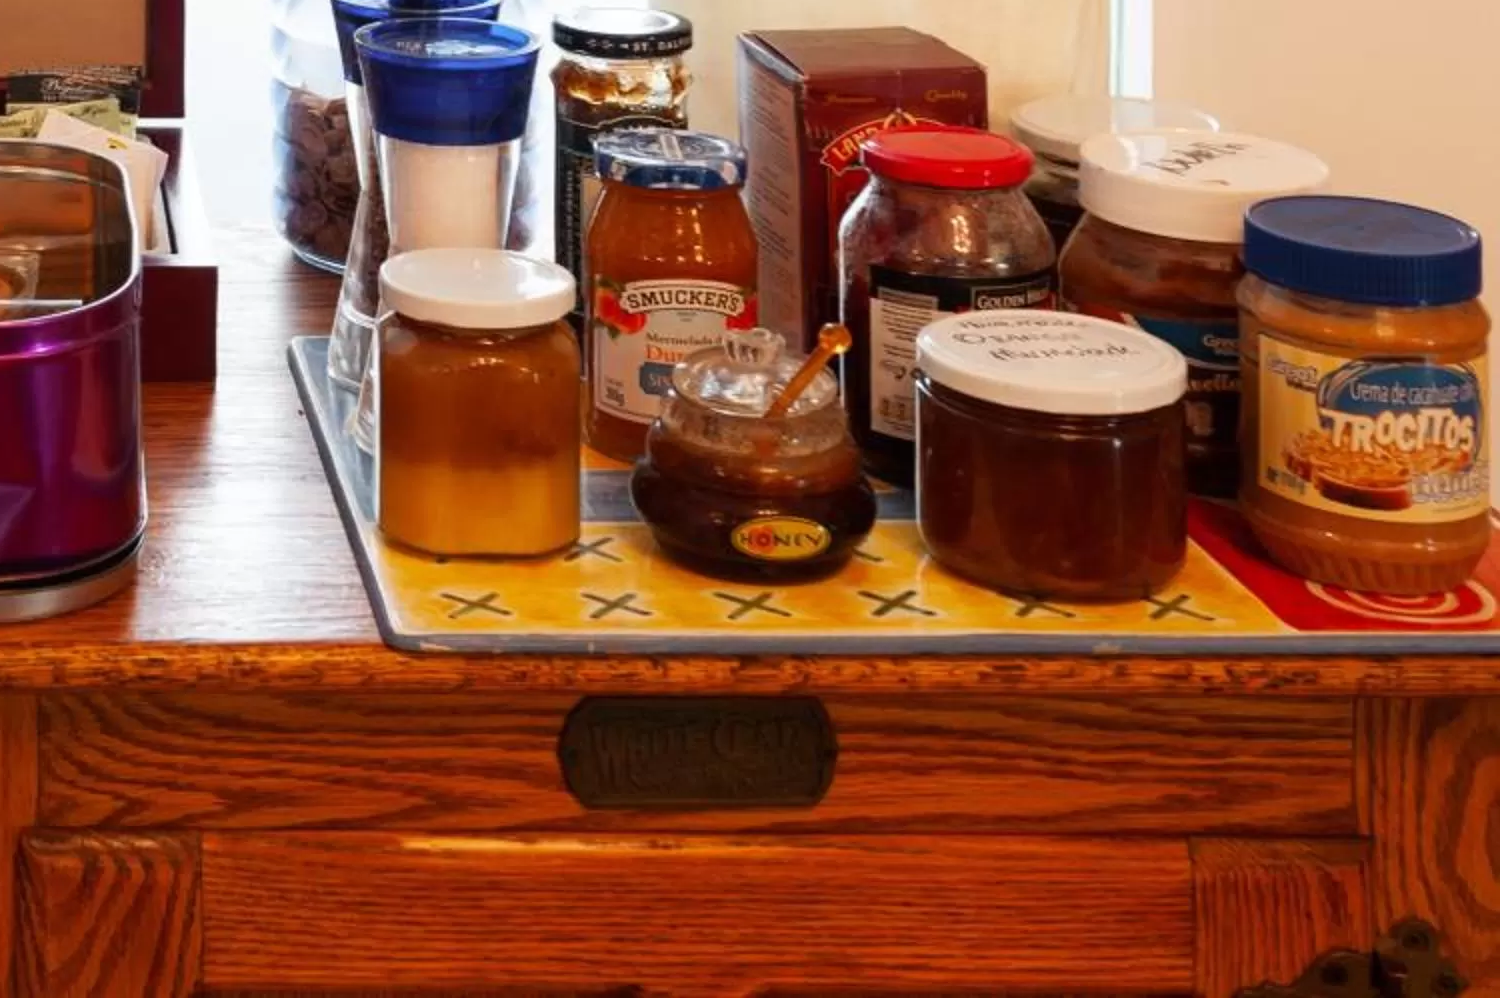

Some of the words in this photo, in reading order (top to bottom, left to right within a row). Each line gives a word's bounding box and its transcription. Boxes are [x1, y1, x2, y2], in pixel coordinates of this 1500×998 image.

[626, 289, 741, 313] SMUCKER'S
[1350, 378, 1389, 402] Crema
[1392, 381, 1407, 404] de
[1318, 407, 1475, 453] TROCITOS
[739, 529, 823, 548] HONEY
